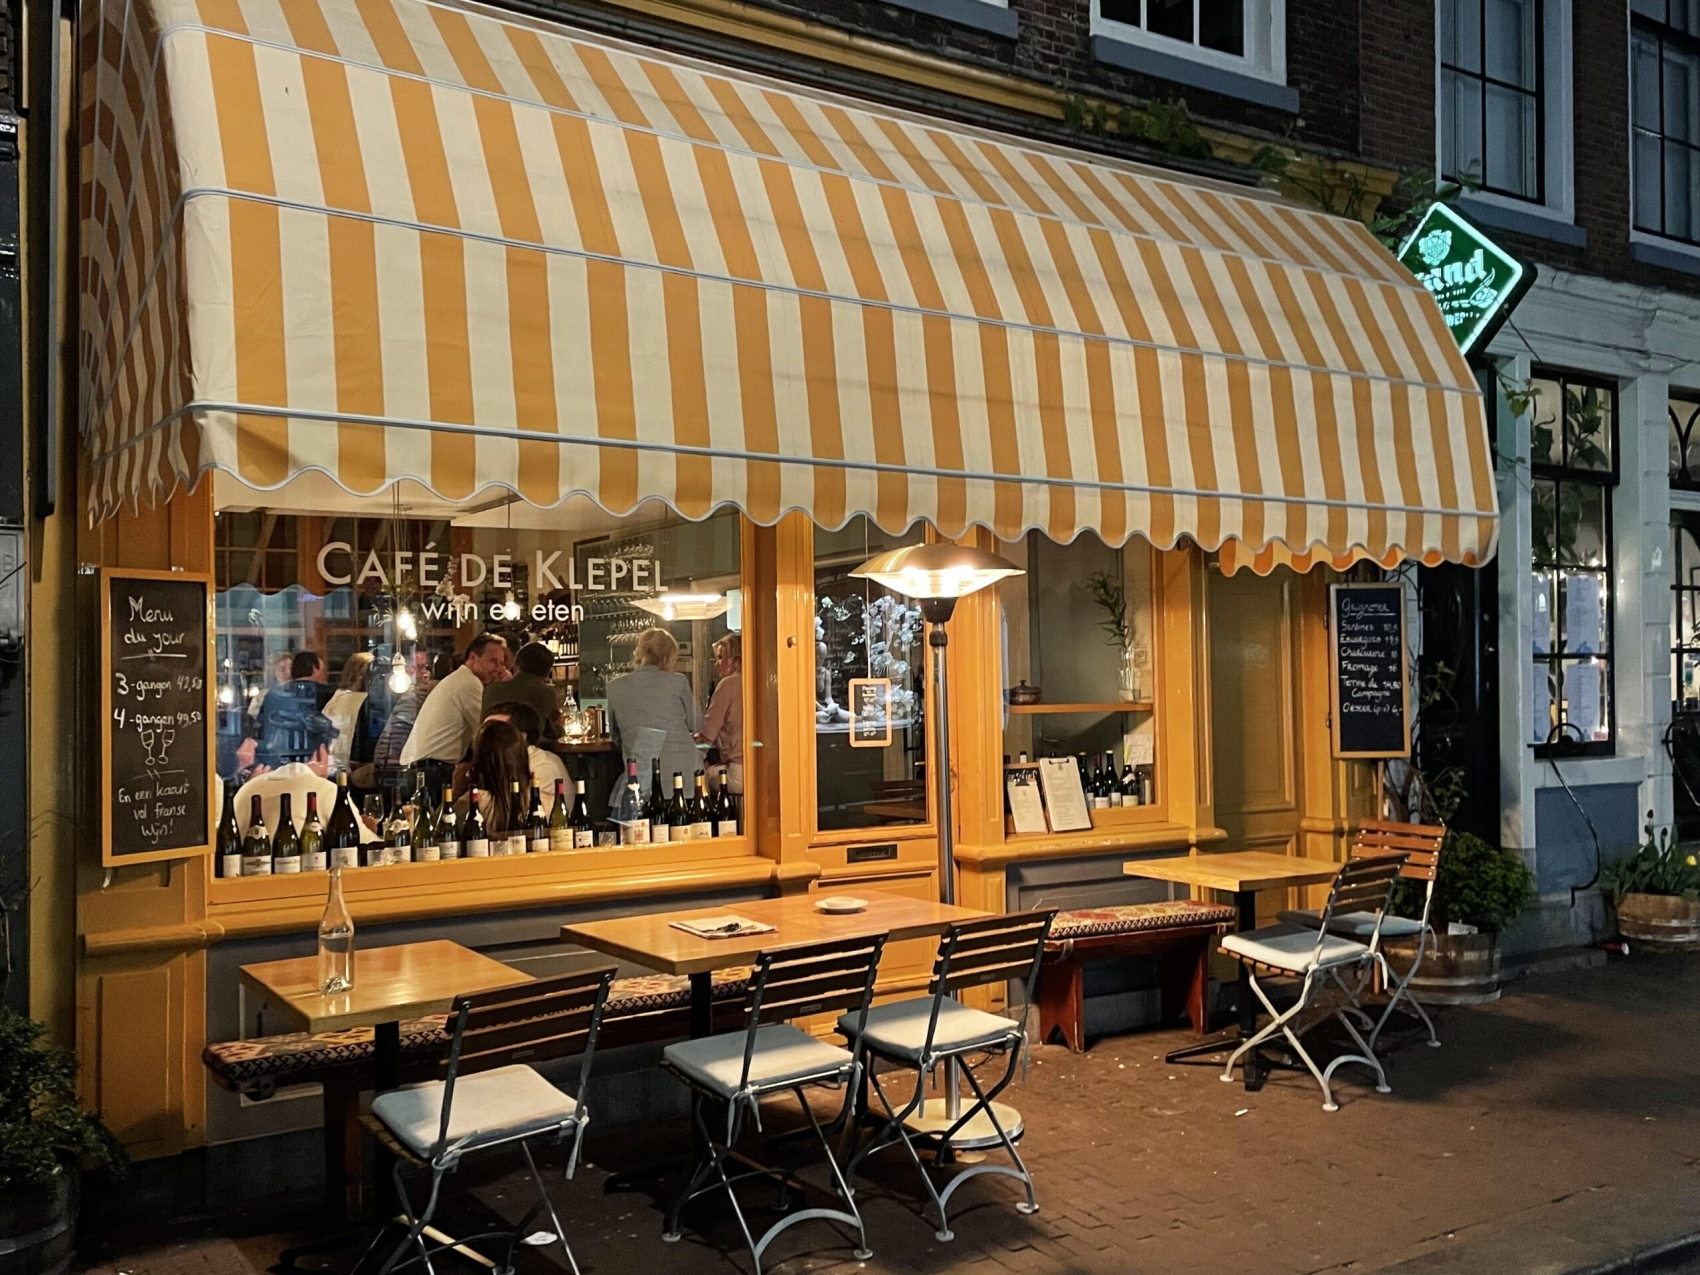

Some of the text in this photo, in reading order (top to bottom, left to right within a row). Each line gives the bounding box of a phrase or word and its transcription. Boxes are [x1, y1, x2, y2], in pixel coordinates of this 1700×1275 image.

[1414, 249, 1487, 291] and
[317, 541, 669, 592] CAFÉ DE KLEPEL
[128, 595, 174, 623] Menu
[420, 599, 584, 628] wijn en eten
[124, 627, 147, 644] du
[1342, 660, 1379, 678] Fromage
[1368, 678, 1379, 689] de
[1351, 687, 1391, 703] Campagne
[118, 778, 190, 803] En een kaart
[133, 803, 147, 821] vol
